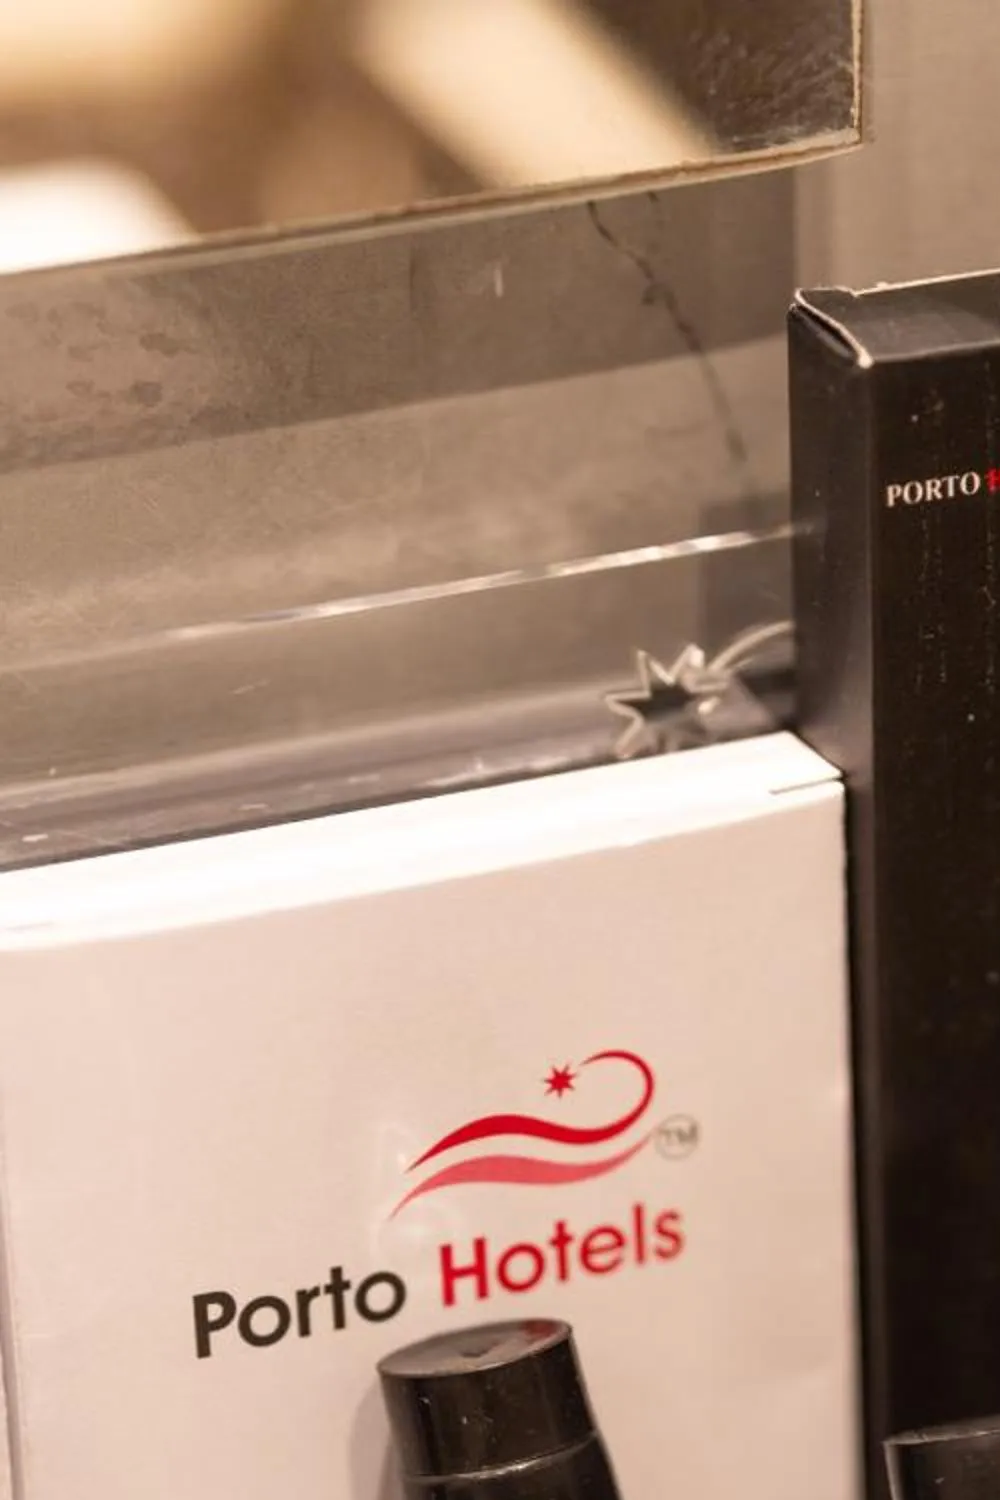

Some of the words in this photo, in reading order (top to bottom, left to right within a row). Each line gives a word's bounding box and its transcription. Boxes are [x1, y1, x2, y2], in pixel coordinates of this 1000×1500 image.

[885, 471, 981, 508] PORTO
[191, 1265, 408, 1359] Porto
[438, 1202, 685, 1308] Hotels
